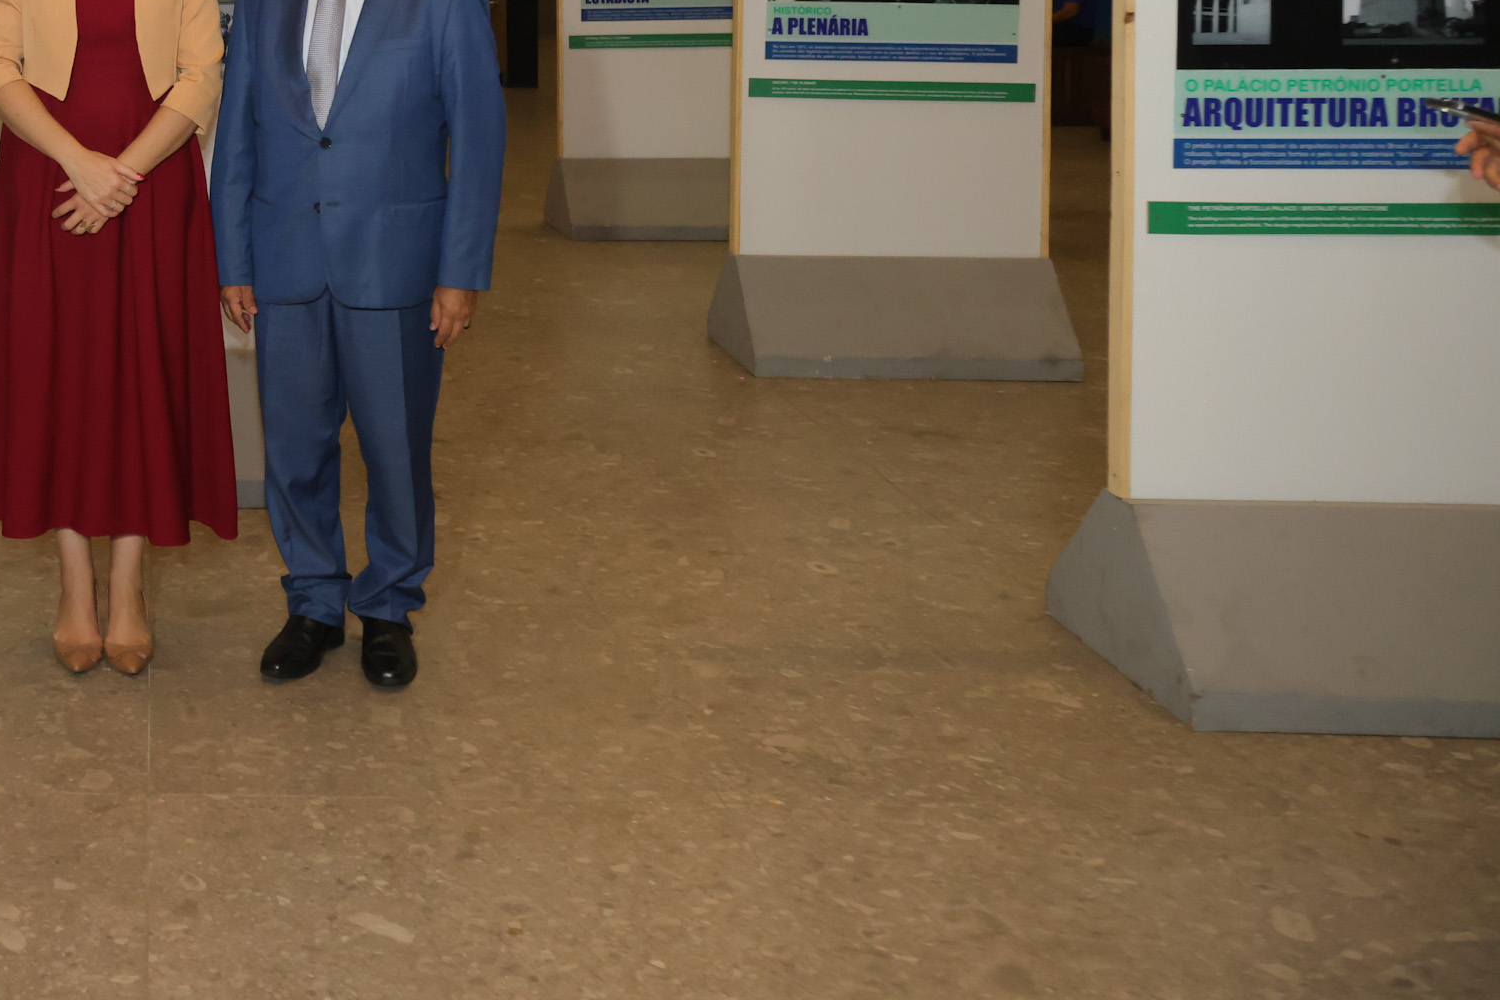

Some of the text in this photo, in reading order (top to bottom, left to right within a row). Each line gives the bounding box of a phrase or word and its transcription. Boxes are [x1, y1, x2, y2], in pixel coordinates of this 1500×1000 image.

[774, 6, 832, 15] HISTÓRICO
[772, 14, 868, 36] A PLENÁRIA
[1186, 76, 1482, 92] O PALÁCIO PETRÔNIO PORTELLA
[1183, 97, 1388, 130] ARQUITETURA
